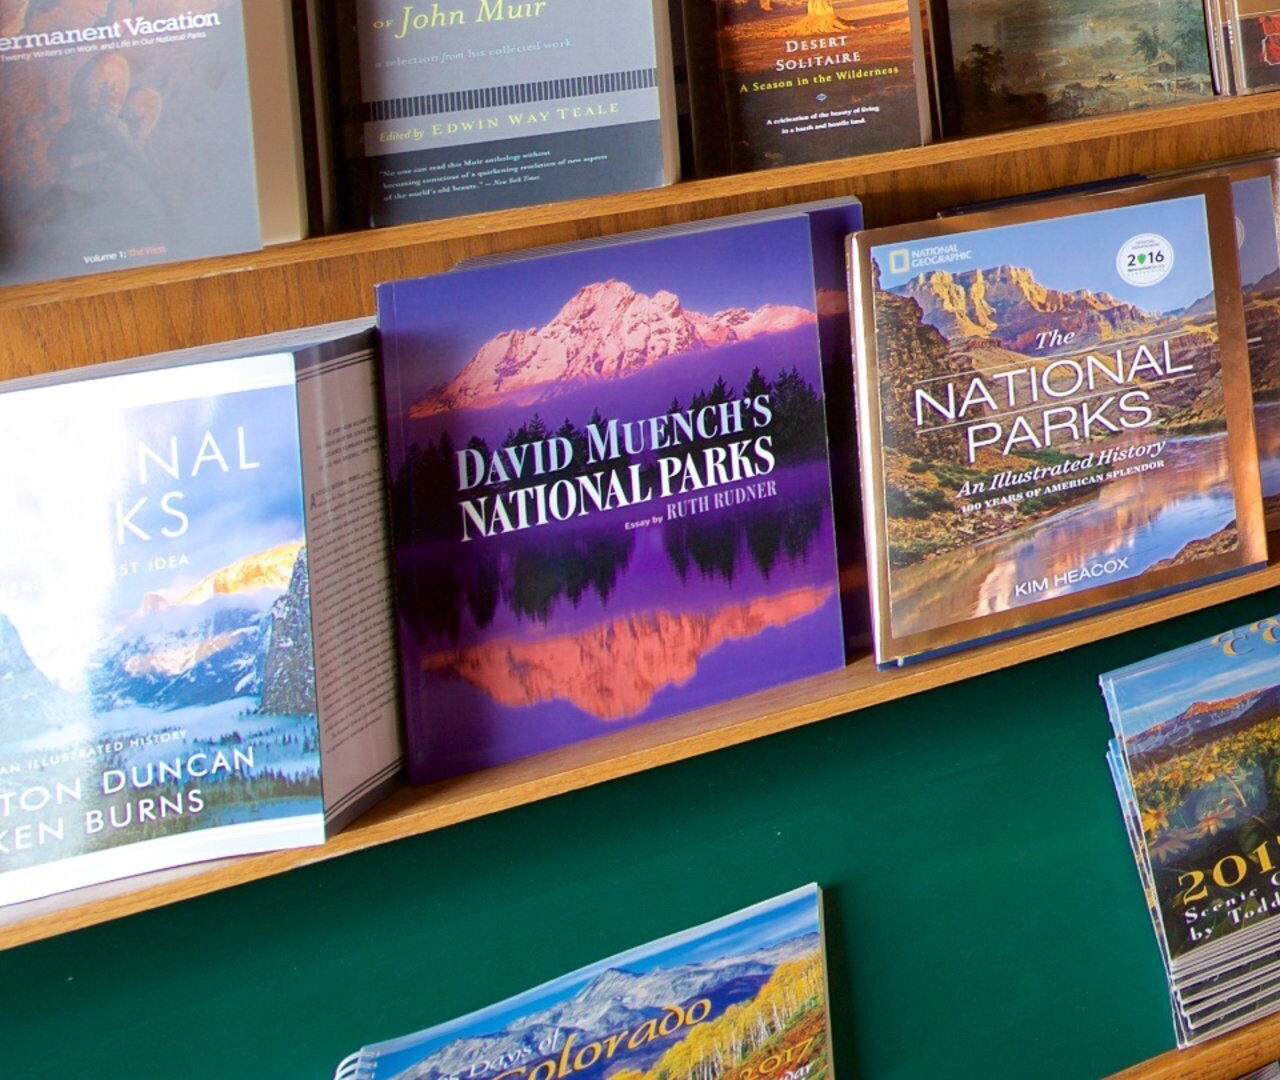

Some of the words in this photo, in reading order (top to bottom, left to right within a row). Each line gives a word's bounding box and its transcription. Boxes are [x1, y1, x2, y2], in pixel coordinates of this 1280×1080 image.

[123, 10, 221, 36] Vacation
[372, 18, 395, 31] OF
[394, 2, 466, 41] John
[775, 51, 862, 73] SOLITAIRE
[785, 35, 849, 54] DESERT
[739, 83, 749, 94] A
[752, 77, 793, 93] Season
[797, 76, 810, 87] in
[813, 73, 834, 85] the
[836, 66, 900, 82] Wilderness
[379, 128, 412, 143] Edited
[413, 126, 426, 141] by
[431, 115, 500, 136] EDWIN
[507, 110, 552, 127] WAY
[556, 101, 620, 121] TEALE
[911, 242, 960, 260] NATIONAL
[911, 249, 974, 269] GEOGRAPHIC
[1034, 327, 1077, 351] The
[914, 340, 1194, 428] NATIONAL
[455, 436, 574, 493] DAVID
[586, 393, 775, 466] MUENCH'S
[966, 390, 1155, 465] PARKS
[458, 462, 654, 544] NATIONAL
[658, 434, 777, 501] PARKS
[955, 478, 987, 500] An
[990, 451, 1094, 494] Illustrated
[1097, 438, 1168, 472] History
[960, 499, 983, 514] 100
[984, 491, 1024, 511] YEARS
[1025, 489, 1042, 502] OF
[1043, 475, 1104, 499] AMERICAN
[1105, 458, 1166, 483] SPLENDOR
[624, 514, 652, 532] Essay
[652, 514, 665, 528] by
[666, 495, 711, 523] RUTH
[713, 479, 779, 512] RUDNER
[1014, 576, 1050, 599] KIM
[1053, 555, 1130, 590] HEACOX
[1184, 886, 1259, 926] Scenic
[1188, 924, 1216, 943] by
[738, 1035, 817, 1080] 2017
